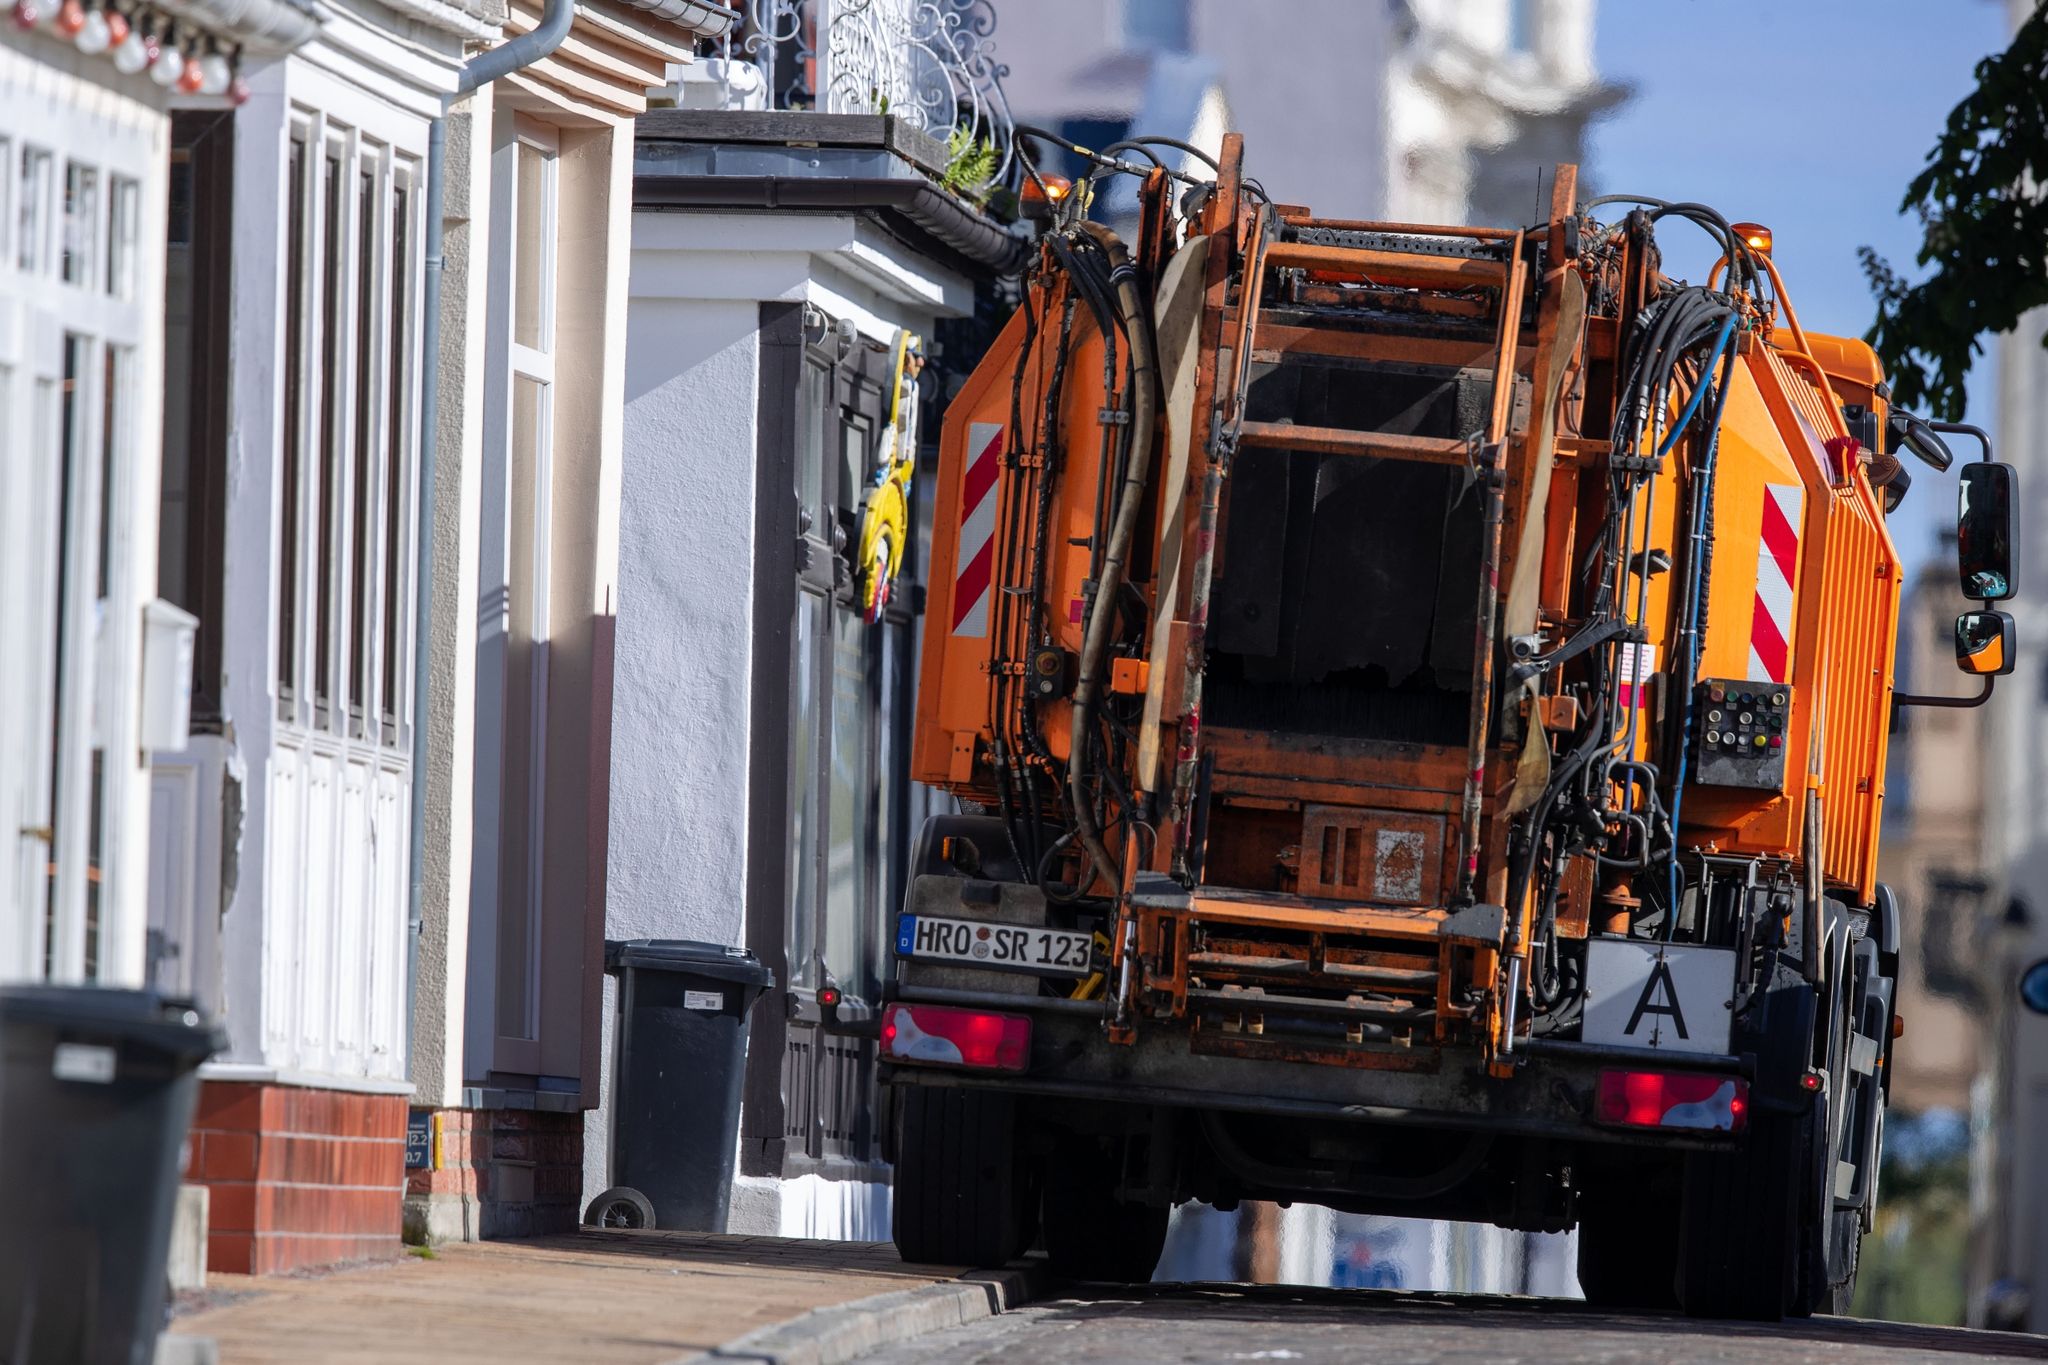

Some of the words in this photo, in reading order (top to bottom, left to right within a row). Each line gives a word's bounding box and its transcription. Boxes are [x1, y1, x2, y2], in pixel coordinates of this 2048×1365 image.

[916, 920, 971, 955] HRO
[993, 929, 1029, 962] SR
[1036, 934, 1090, 967] 123
[1623, 961, 1690, 1040] A
